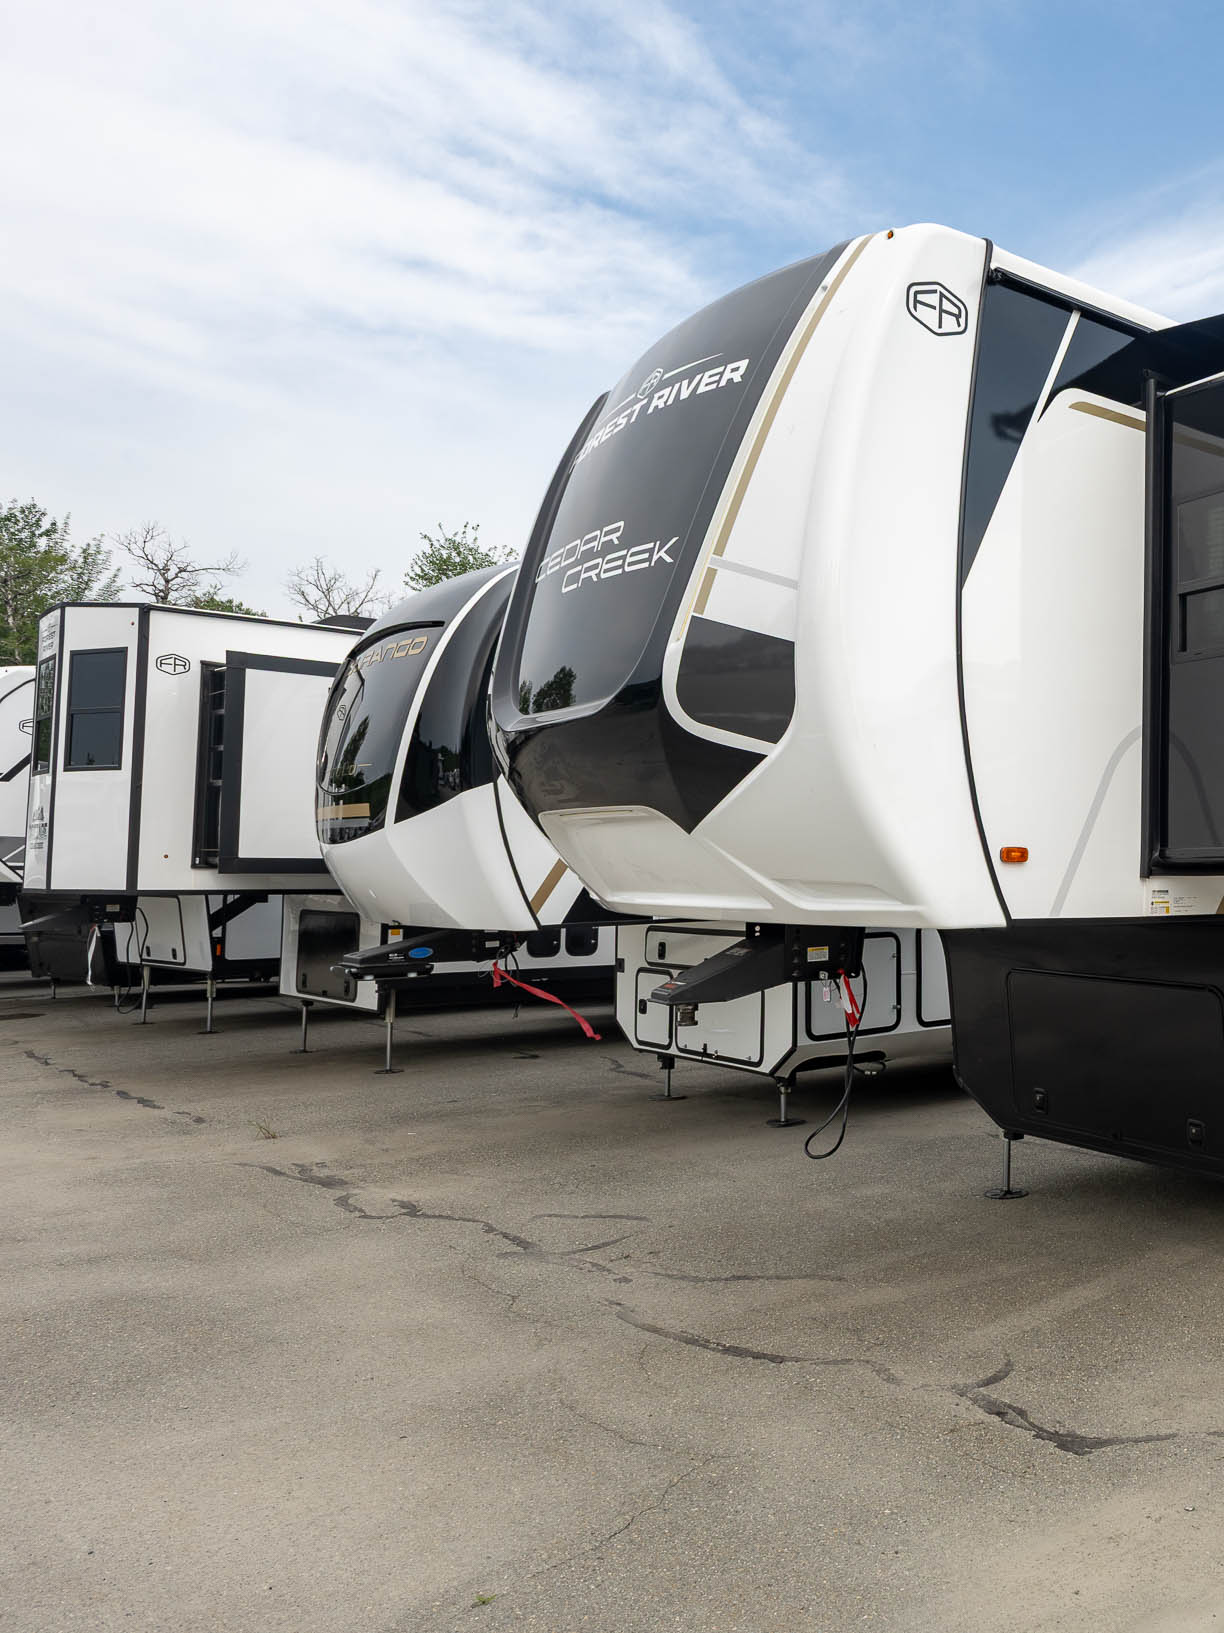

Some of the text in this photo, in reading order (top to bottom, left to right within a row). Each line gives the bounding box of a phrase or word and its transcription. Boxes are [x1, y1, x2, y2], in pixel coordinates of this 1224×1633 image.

[912, 288, 962, 330] FR
[647, 358, 750, 415] RIVER
[535, 520, 680, 594] CEDAR CREEK
[159, 656, 188, 673] FR
